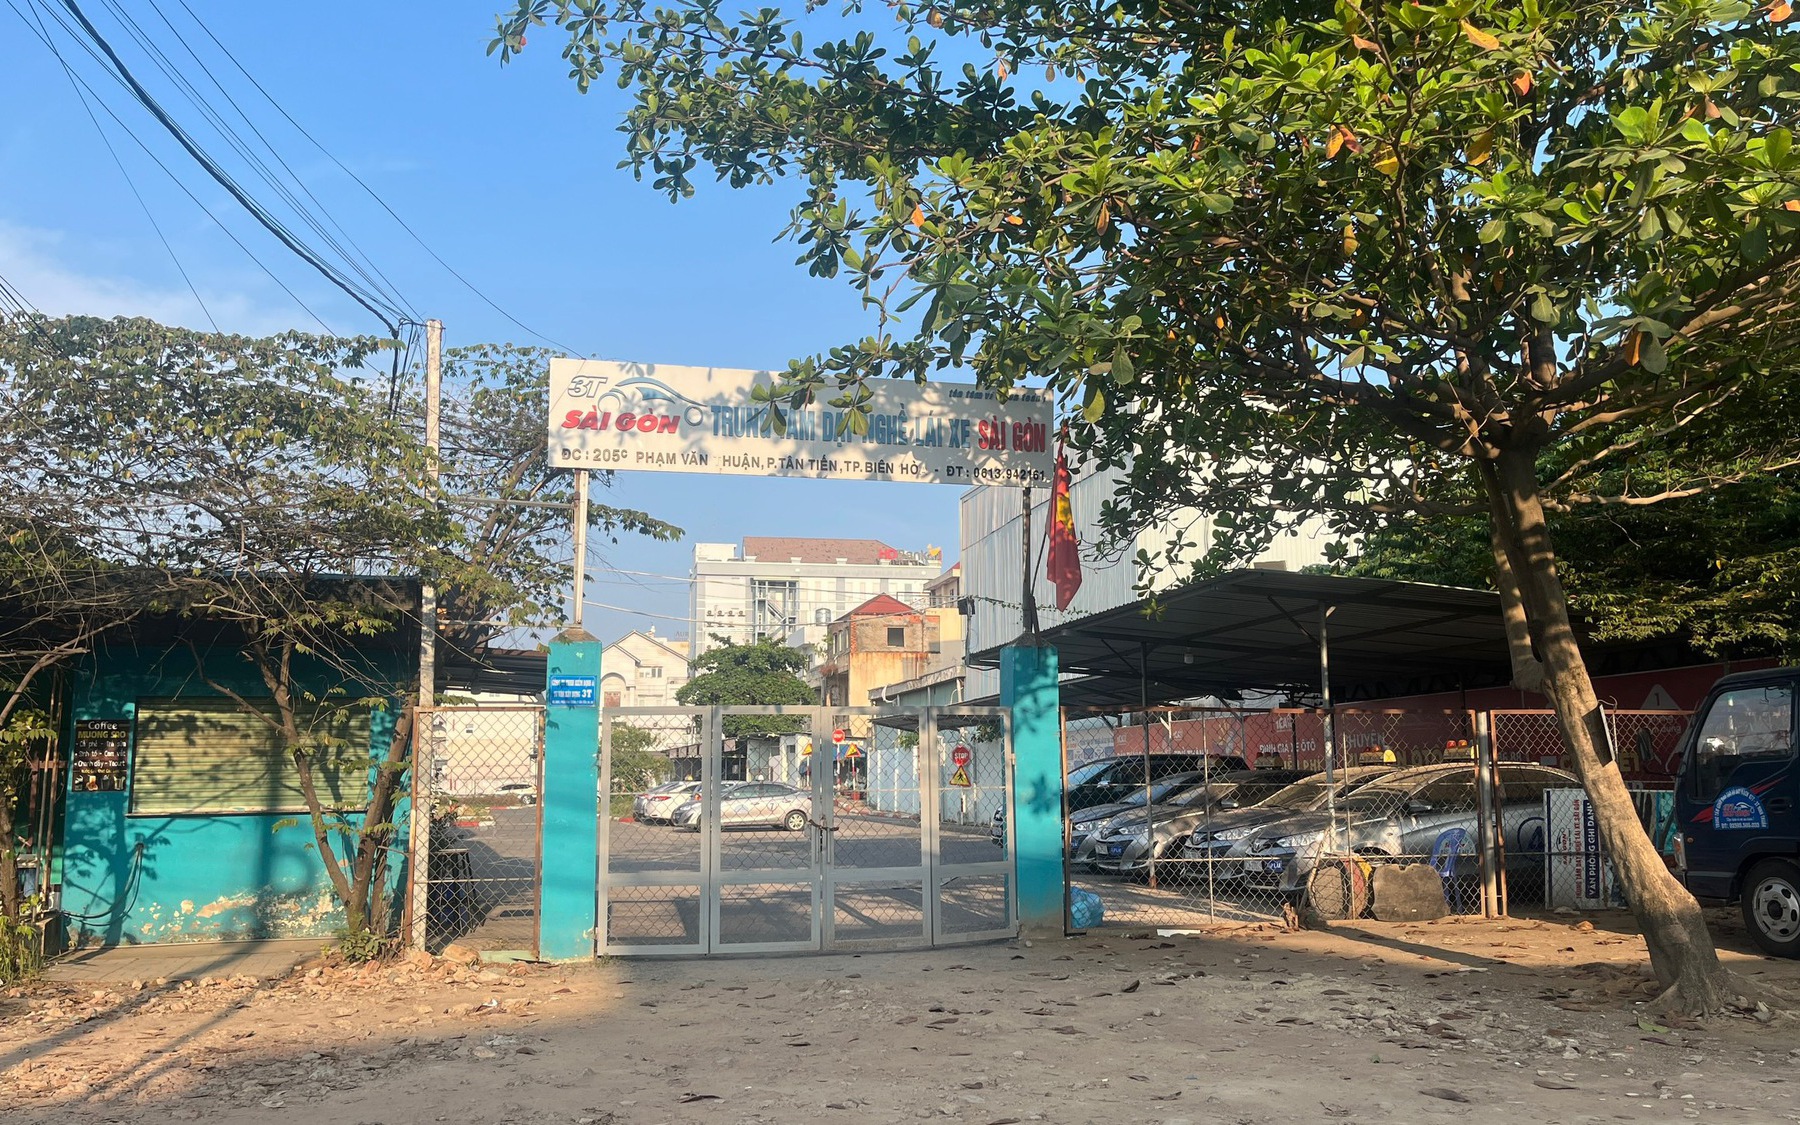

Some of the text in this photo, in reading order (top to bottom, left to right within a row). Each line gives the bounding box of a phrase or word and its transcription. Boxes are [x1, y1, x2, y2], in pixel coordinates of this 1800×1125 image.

[568, 375, 608, 398] 3T
[561, 405, 681, 434] SÀI GÒN
[711, 405, 771, 439] TRUNG
[914, 410, 943, 448] LÁI
[949, 418, 971, 449] XE
[978, 415, 1006, 451] SÀI
[1012, 417, 1046, 453] GÒN
[636, 451, 677, 467] PHẠM
[681, 451, 709, 466] VĂN
[900, 460, 927, 475] HÒ
[581, 689, 592, 698] 3T
[88, 721, 118, 730] Coffee
[1587, 828, 1595, 844] GHI
[1588, 877, 1597, 896] VĂN
